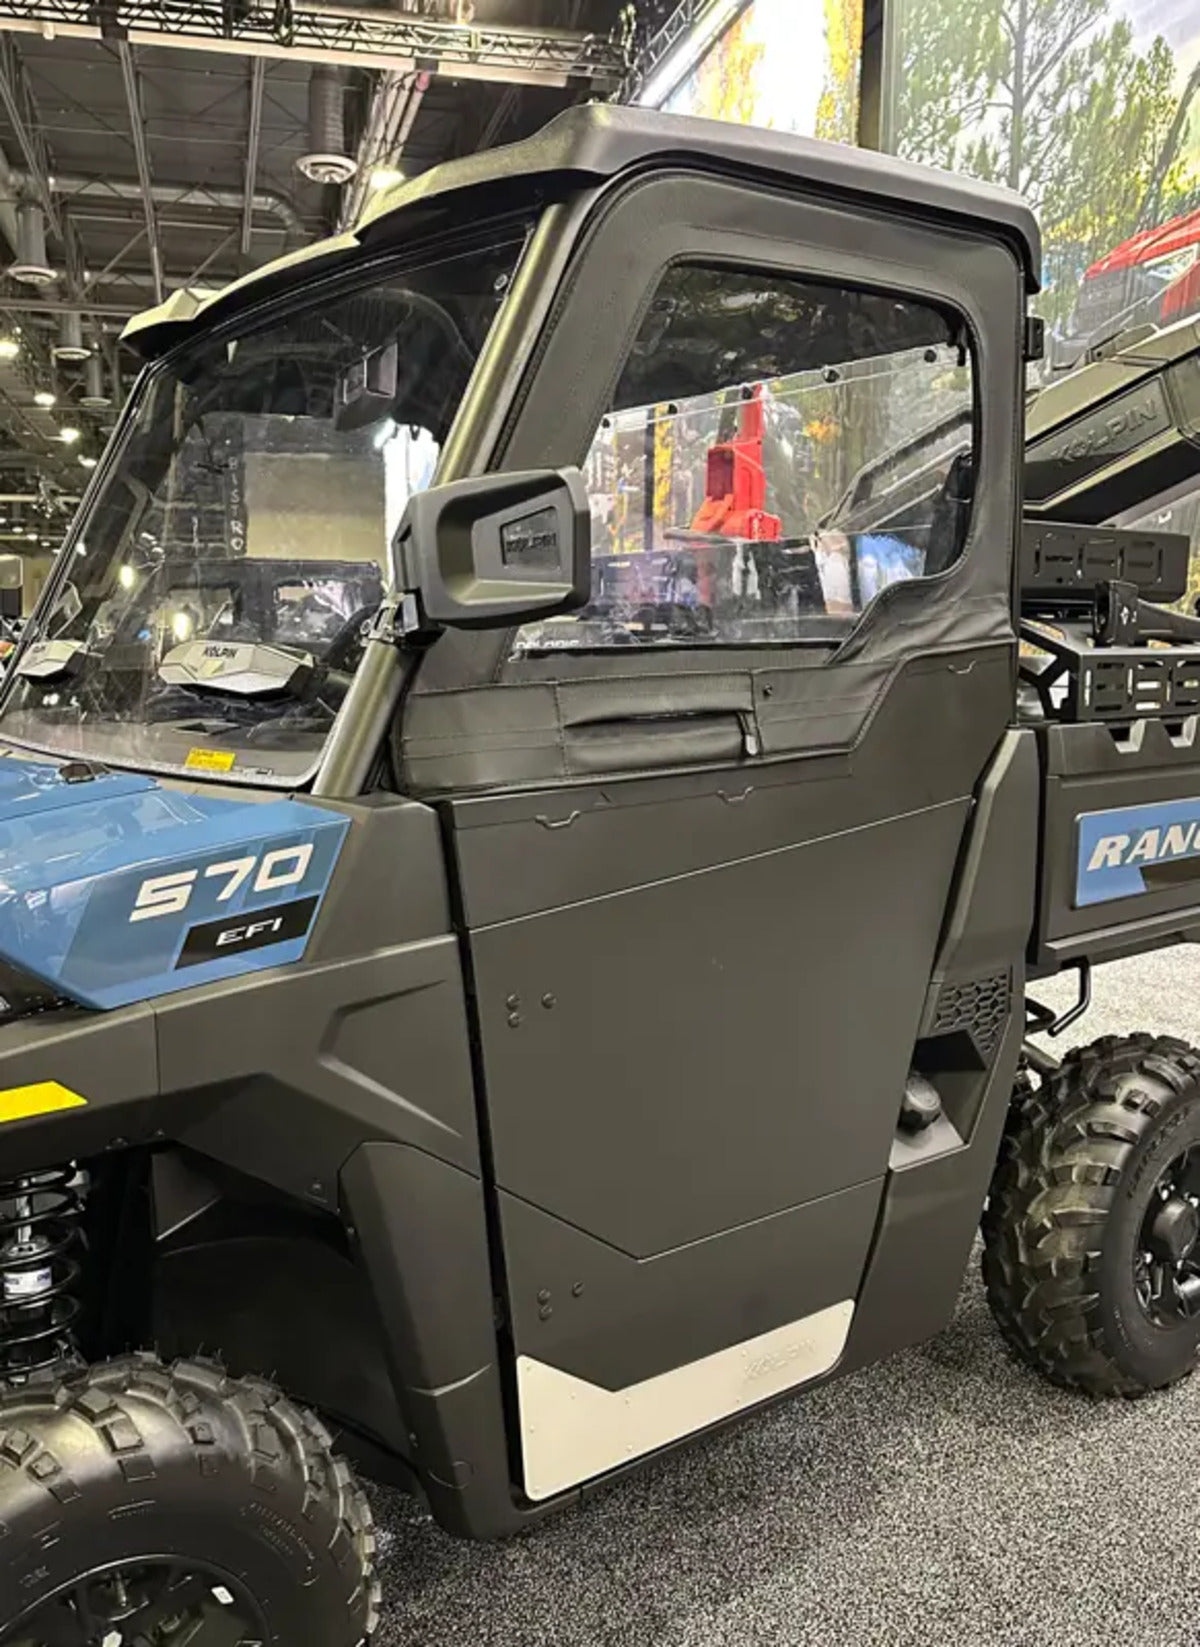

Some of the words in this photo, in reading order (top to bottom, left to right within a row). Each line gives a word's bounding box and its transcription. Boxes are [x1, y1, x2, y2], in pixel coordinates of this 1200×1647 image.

[1050, 399, 1158, 464] KOLPIN
[129, 843, 314, 923] 570
[215, 917, 283, 946] EFI
